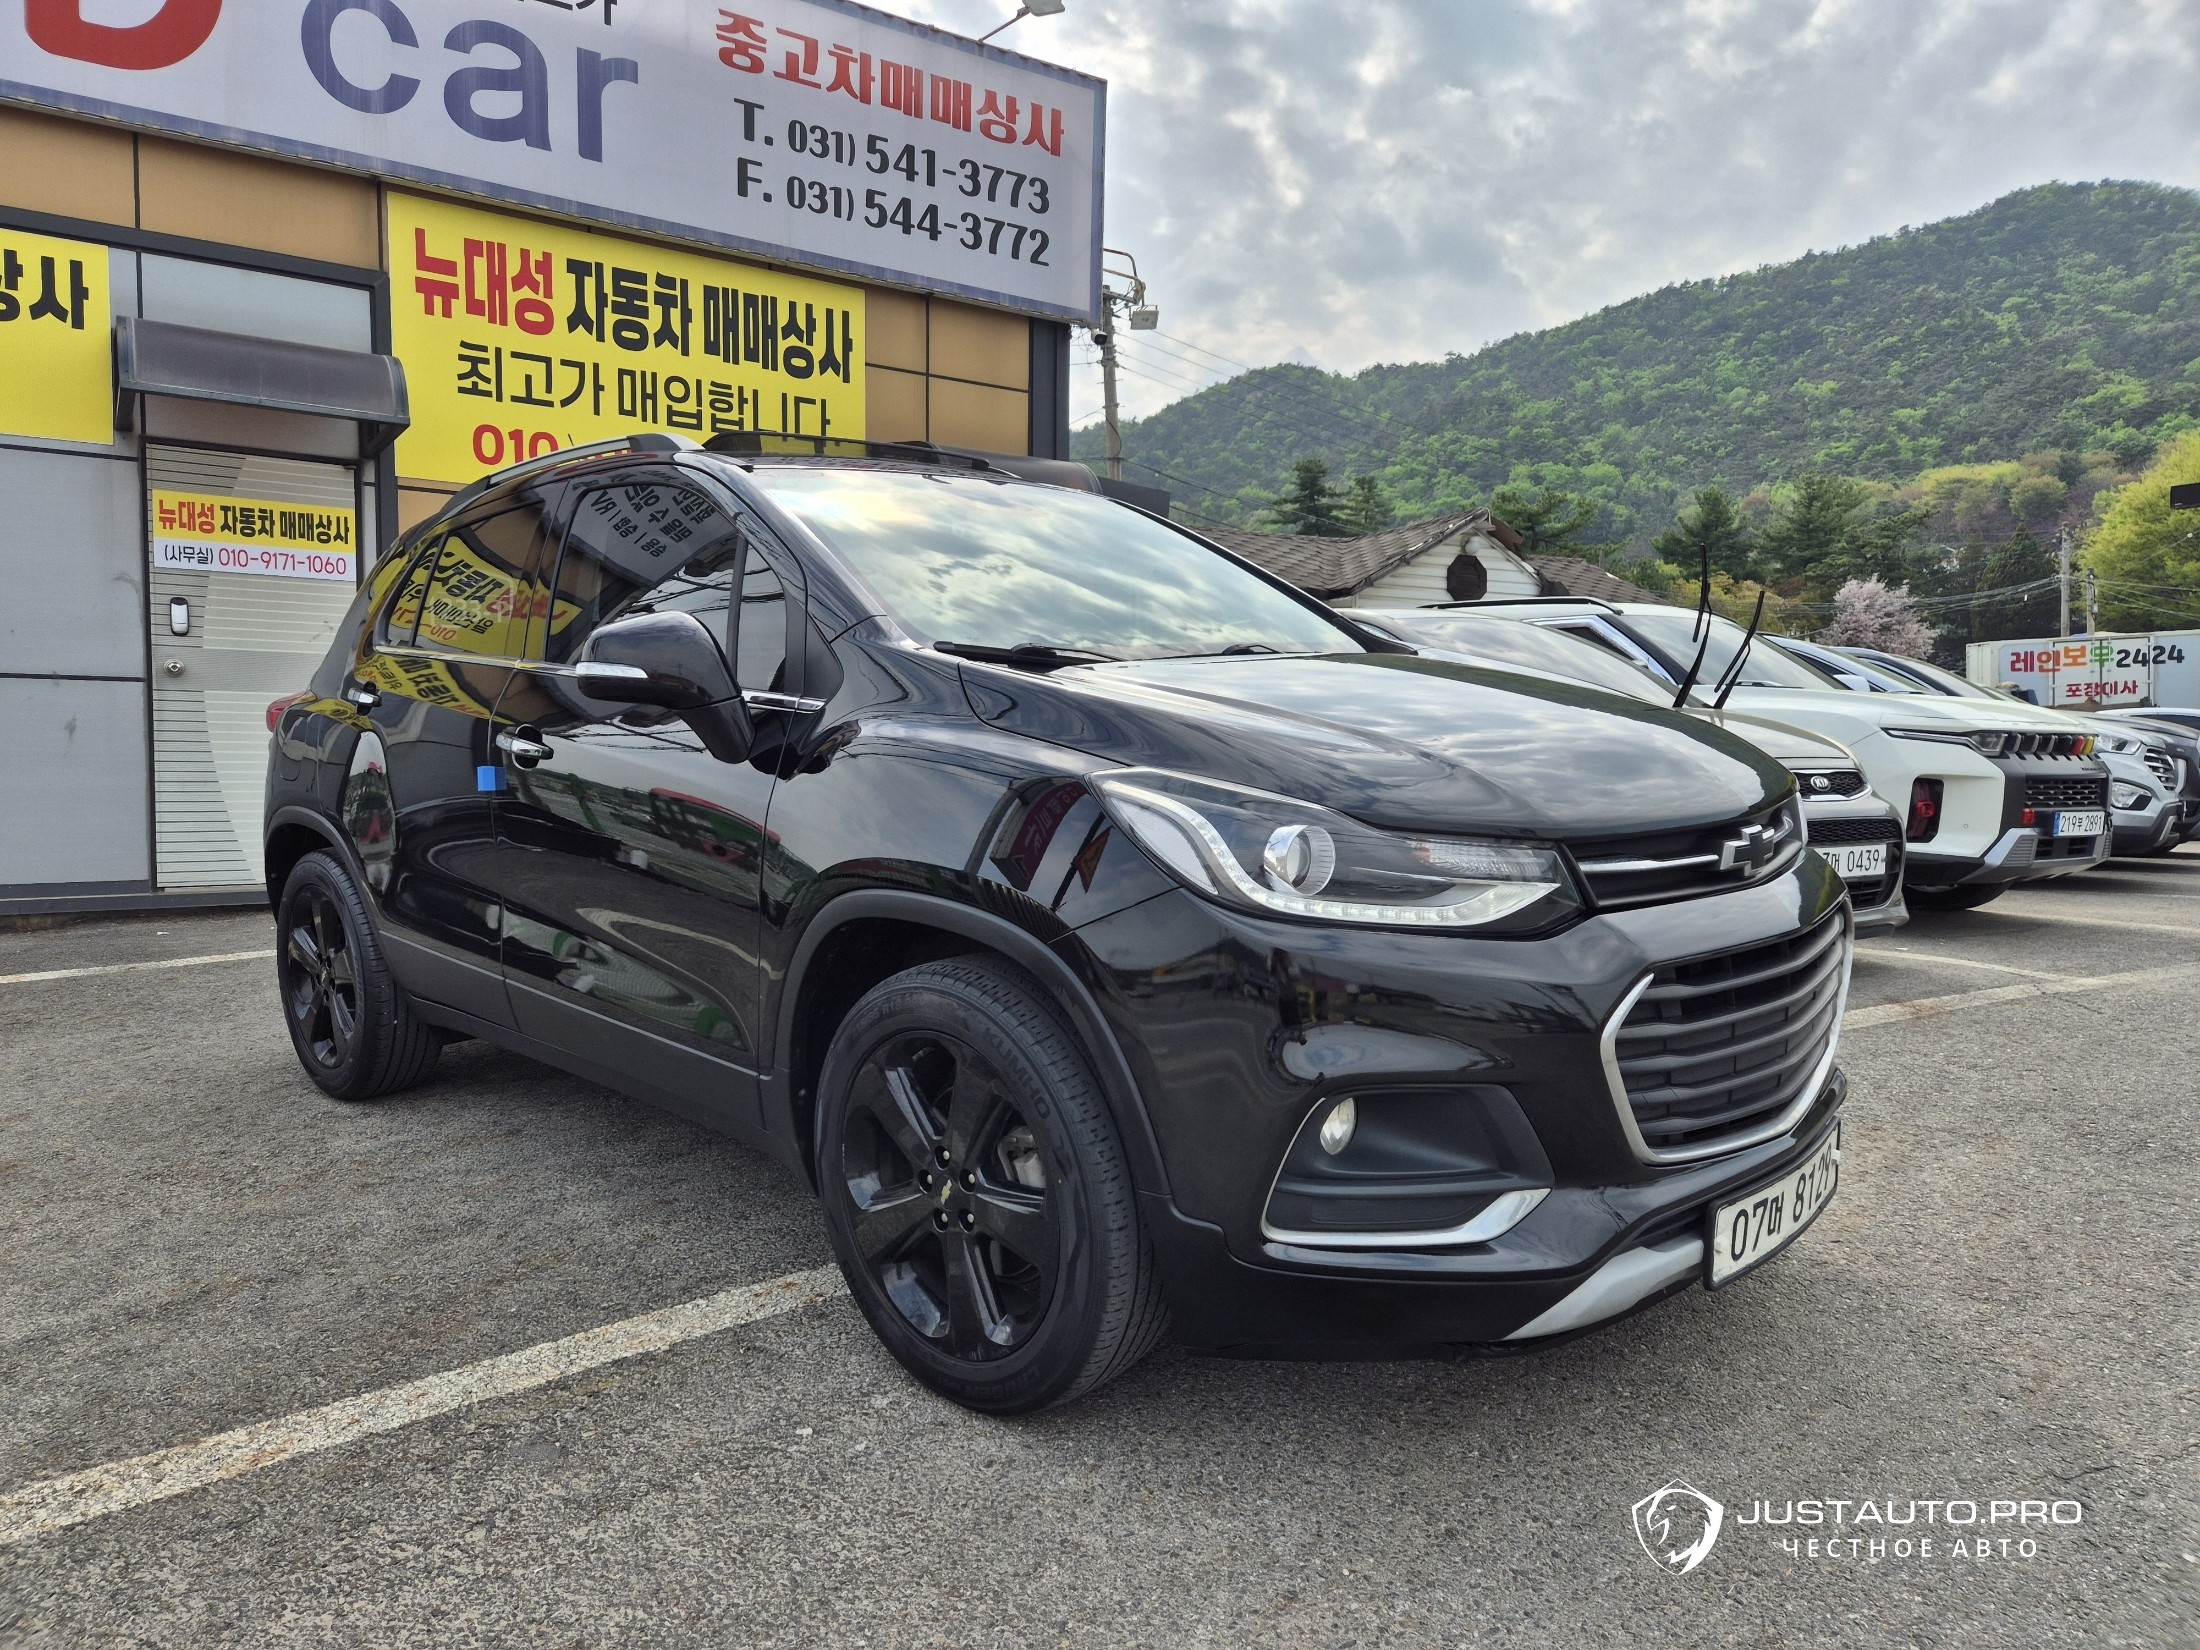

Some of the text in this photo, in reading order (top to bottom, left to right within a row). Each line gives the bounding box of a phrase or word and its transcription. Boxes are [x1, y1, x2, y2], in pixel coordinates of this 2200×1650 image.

[301, 0, 639, 163] car
[715, 8, 1065, 157] 중고차매매상사
[733, 98, 1050, 215] T. 031) 541-3773
[737, 157, 1050, 267] F. 031) 544-3772
[413, 228, 853, 383] 뉴대성 자동차 매매상사
[457, 340, 831, 442] 최고가 매입합니다
[158, 499, 350, 545] 뉴대성 자동차 매매상사
[164, 544, 347, 575] (사무실) 010-9171-1060
[1847, 848, 1880, 873] 0439
[982, 1026, 1052, 1120] KUMHO
[1731, 1142, 1832, 1263] 07머 8129
